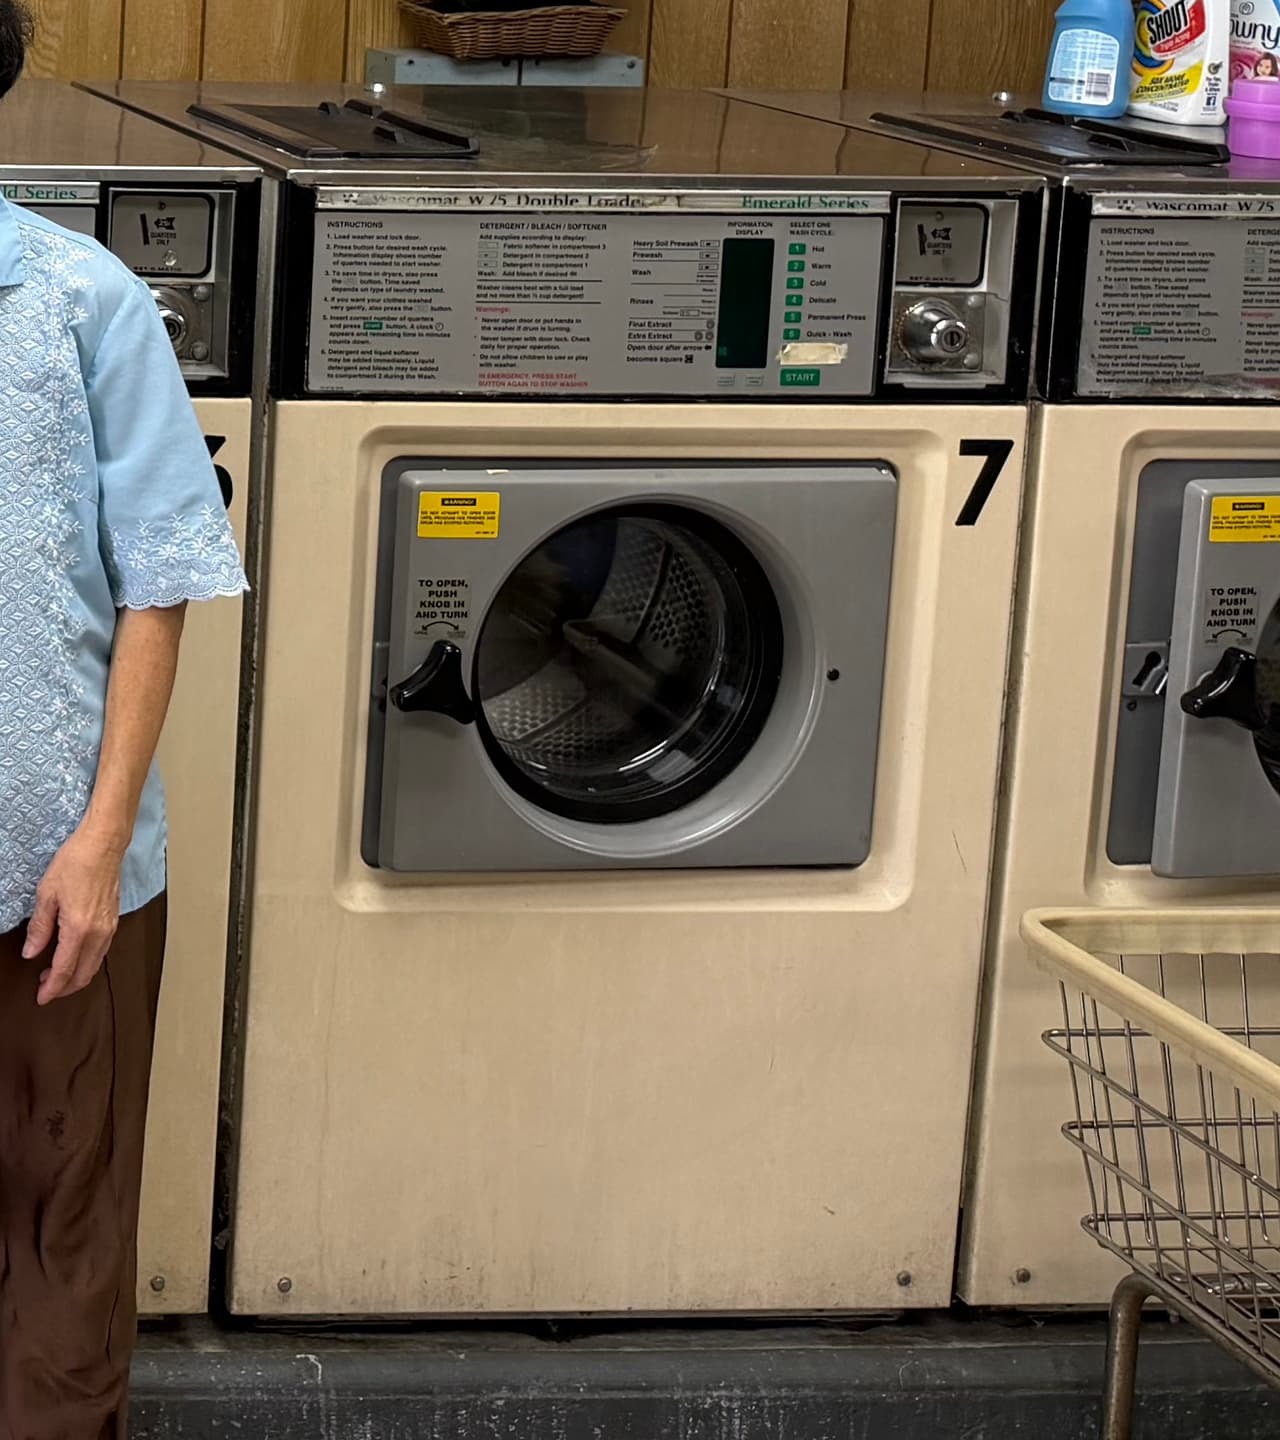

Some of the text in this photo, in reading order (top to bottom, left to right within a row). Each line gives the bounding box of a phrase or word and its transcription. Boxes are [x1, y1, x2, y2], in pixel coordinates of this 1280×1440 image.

[742, 195, 869, 209] Emerald Series
[785, 372, 815, 383] START
[955, 438, 1015, 526] 7
